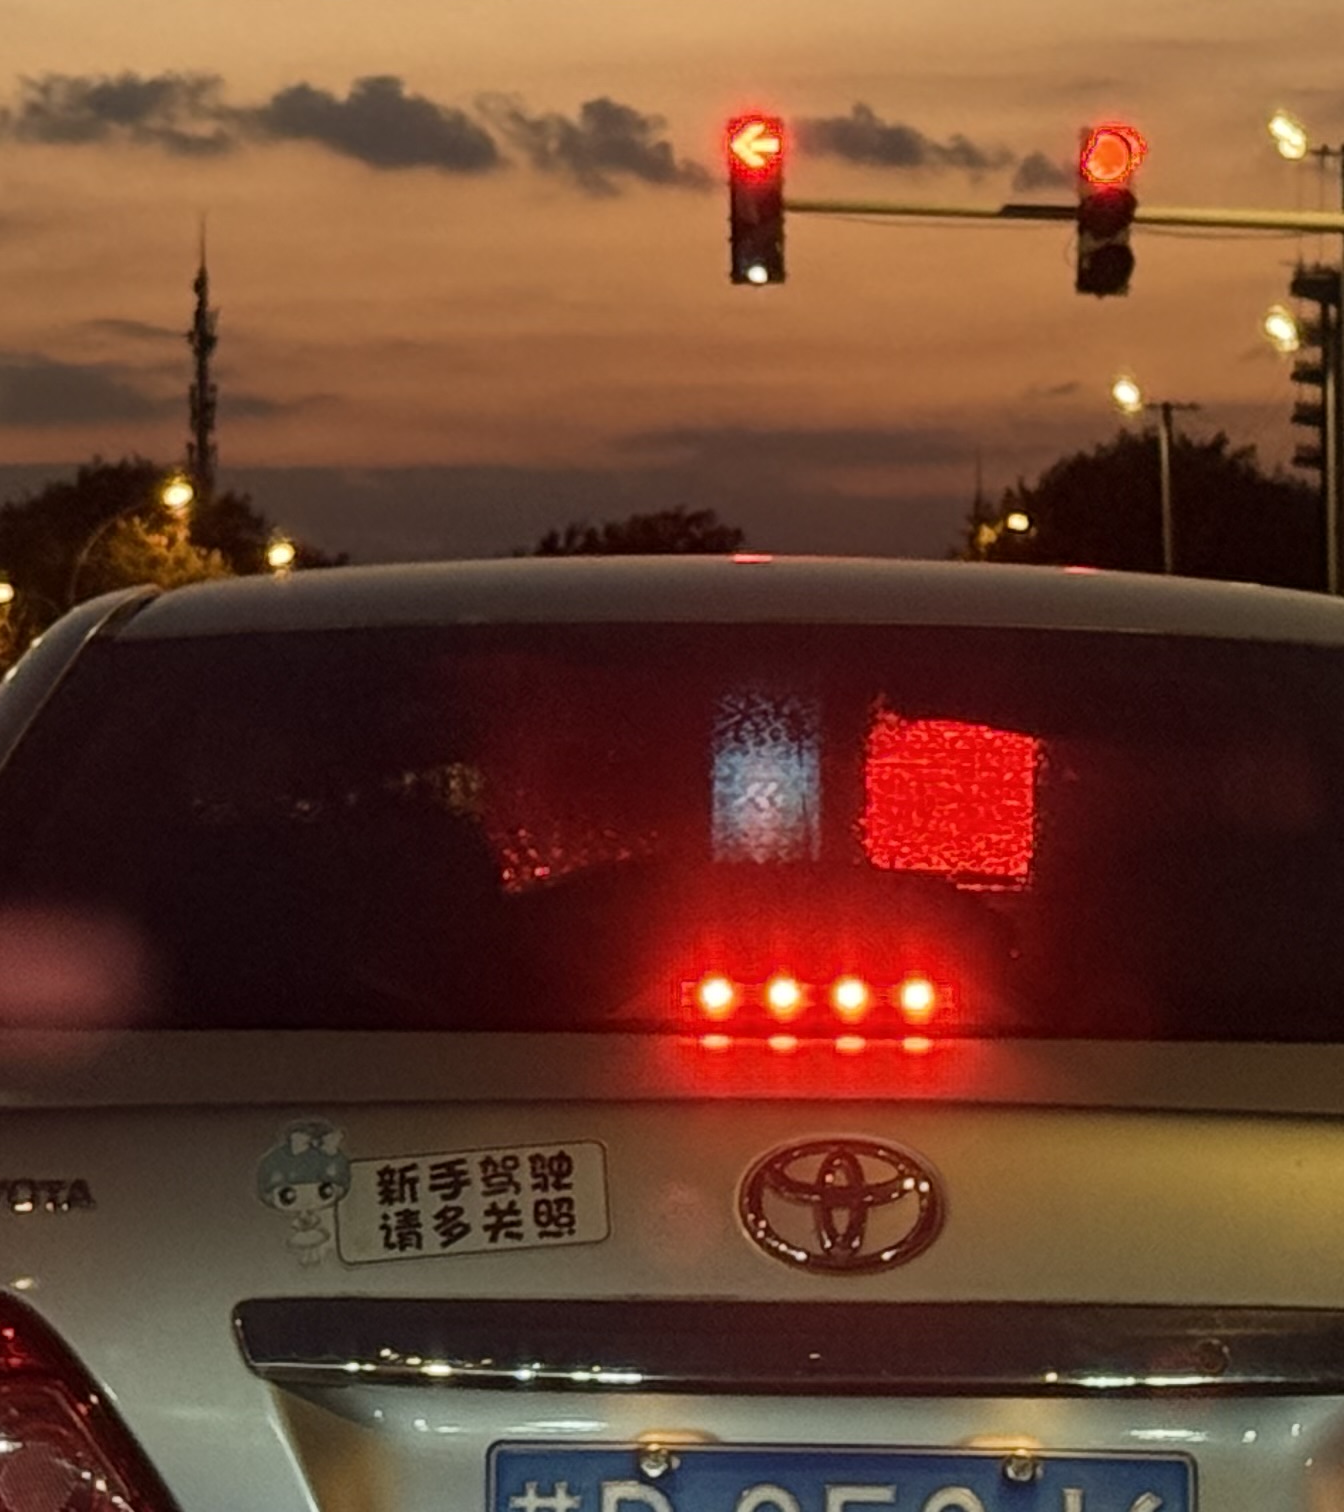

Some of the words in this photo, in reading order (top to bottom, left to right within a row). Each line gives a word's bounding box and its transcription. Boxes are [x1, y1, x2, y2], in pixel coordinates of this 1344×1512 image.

[377, 1151, 573, 1206] 新手驾驶
[379, 1197, 576, 1251] 请多关照
